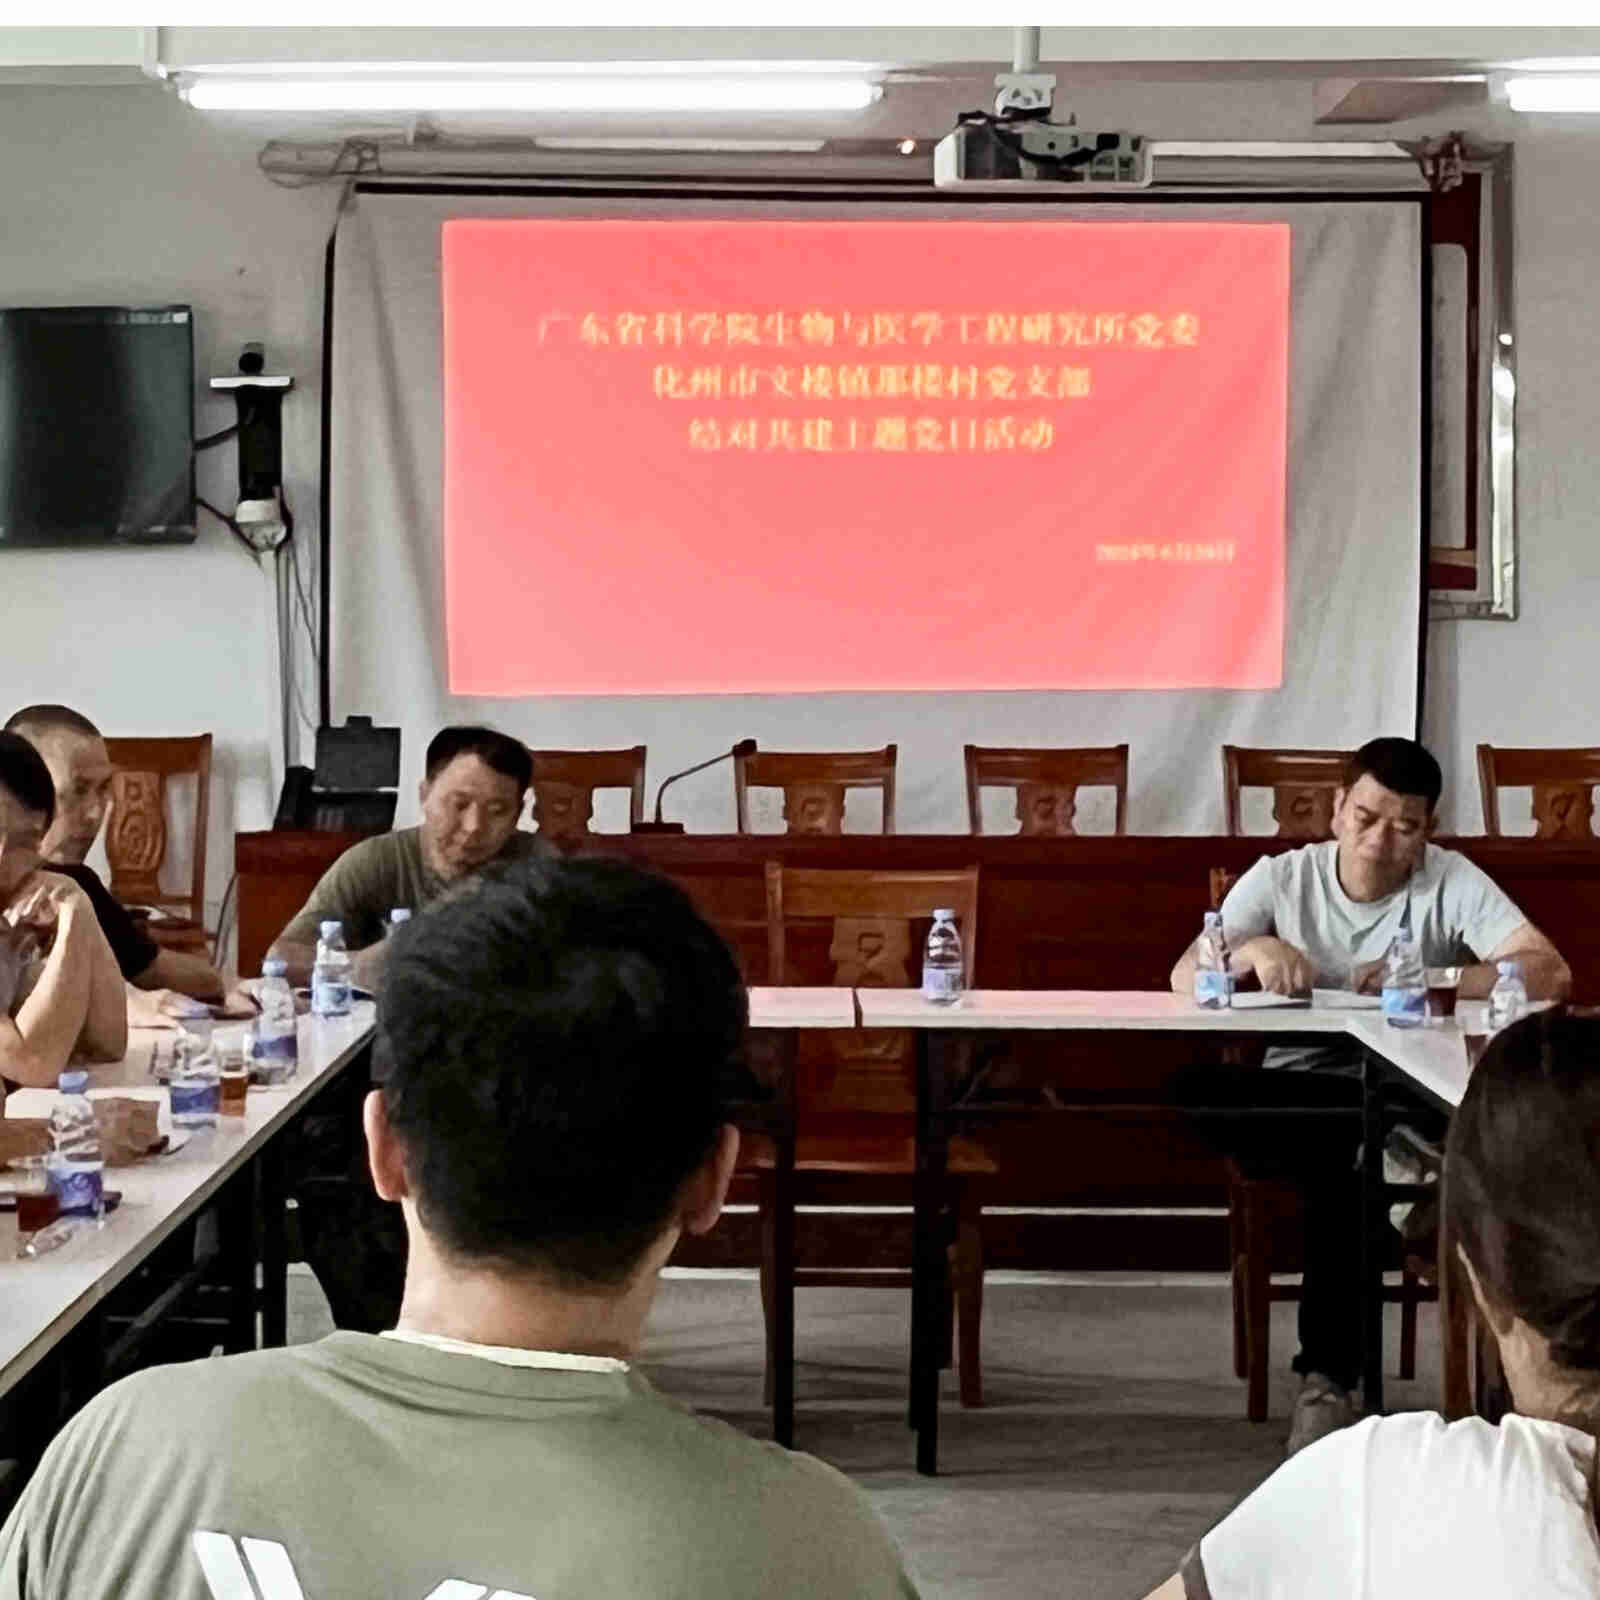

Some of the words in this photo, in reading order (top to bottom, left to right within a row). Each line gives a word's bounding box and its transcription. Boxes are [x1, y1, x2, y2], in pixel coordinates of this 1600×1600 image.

[652, 364, 1092, 400] 化州市文楼镇那楼村党支部
[688, 416, 1056, 453] 结对共建主题党日活动
